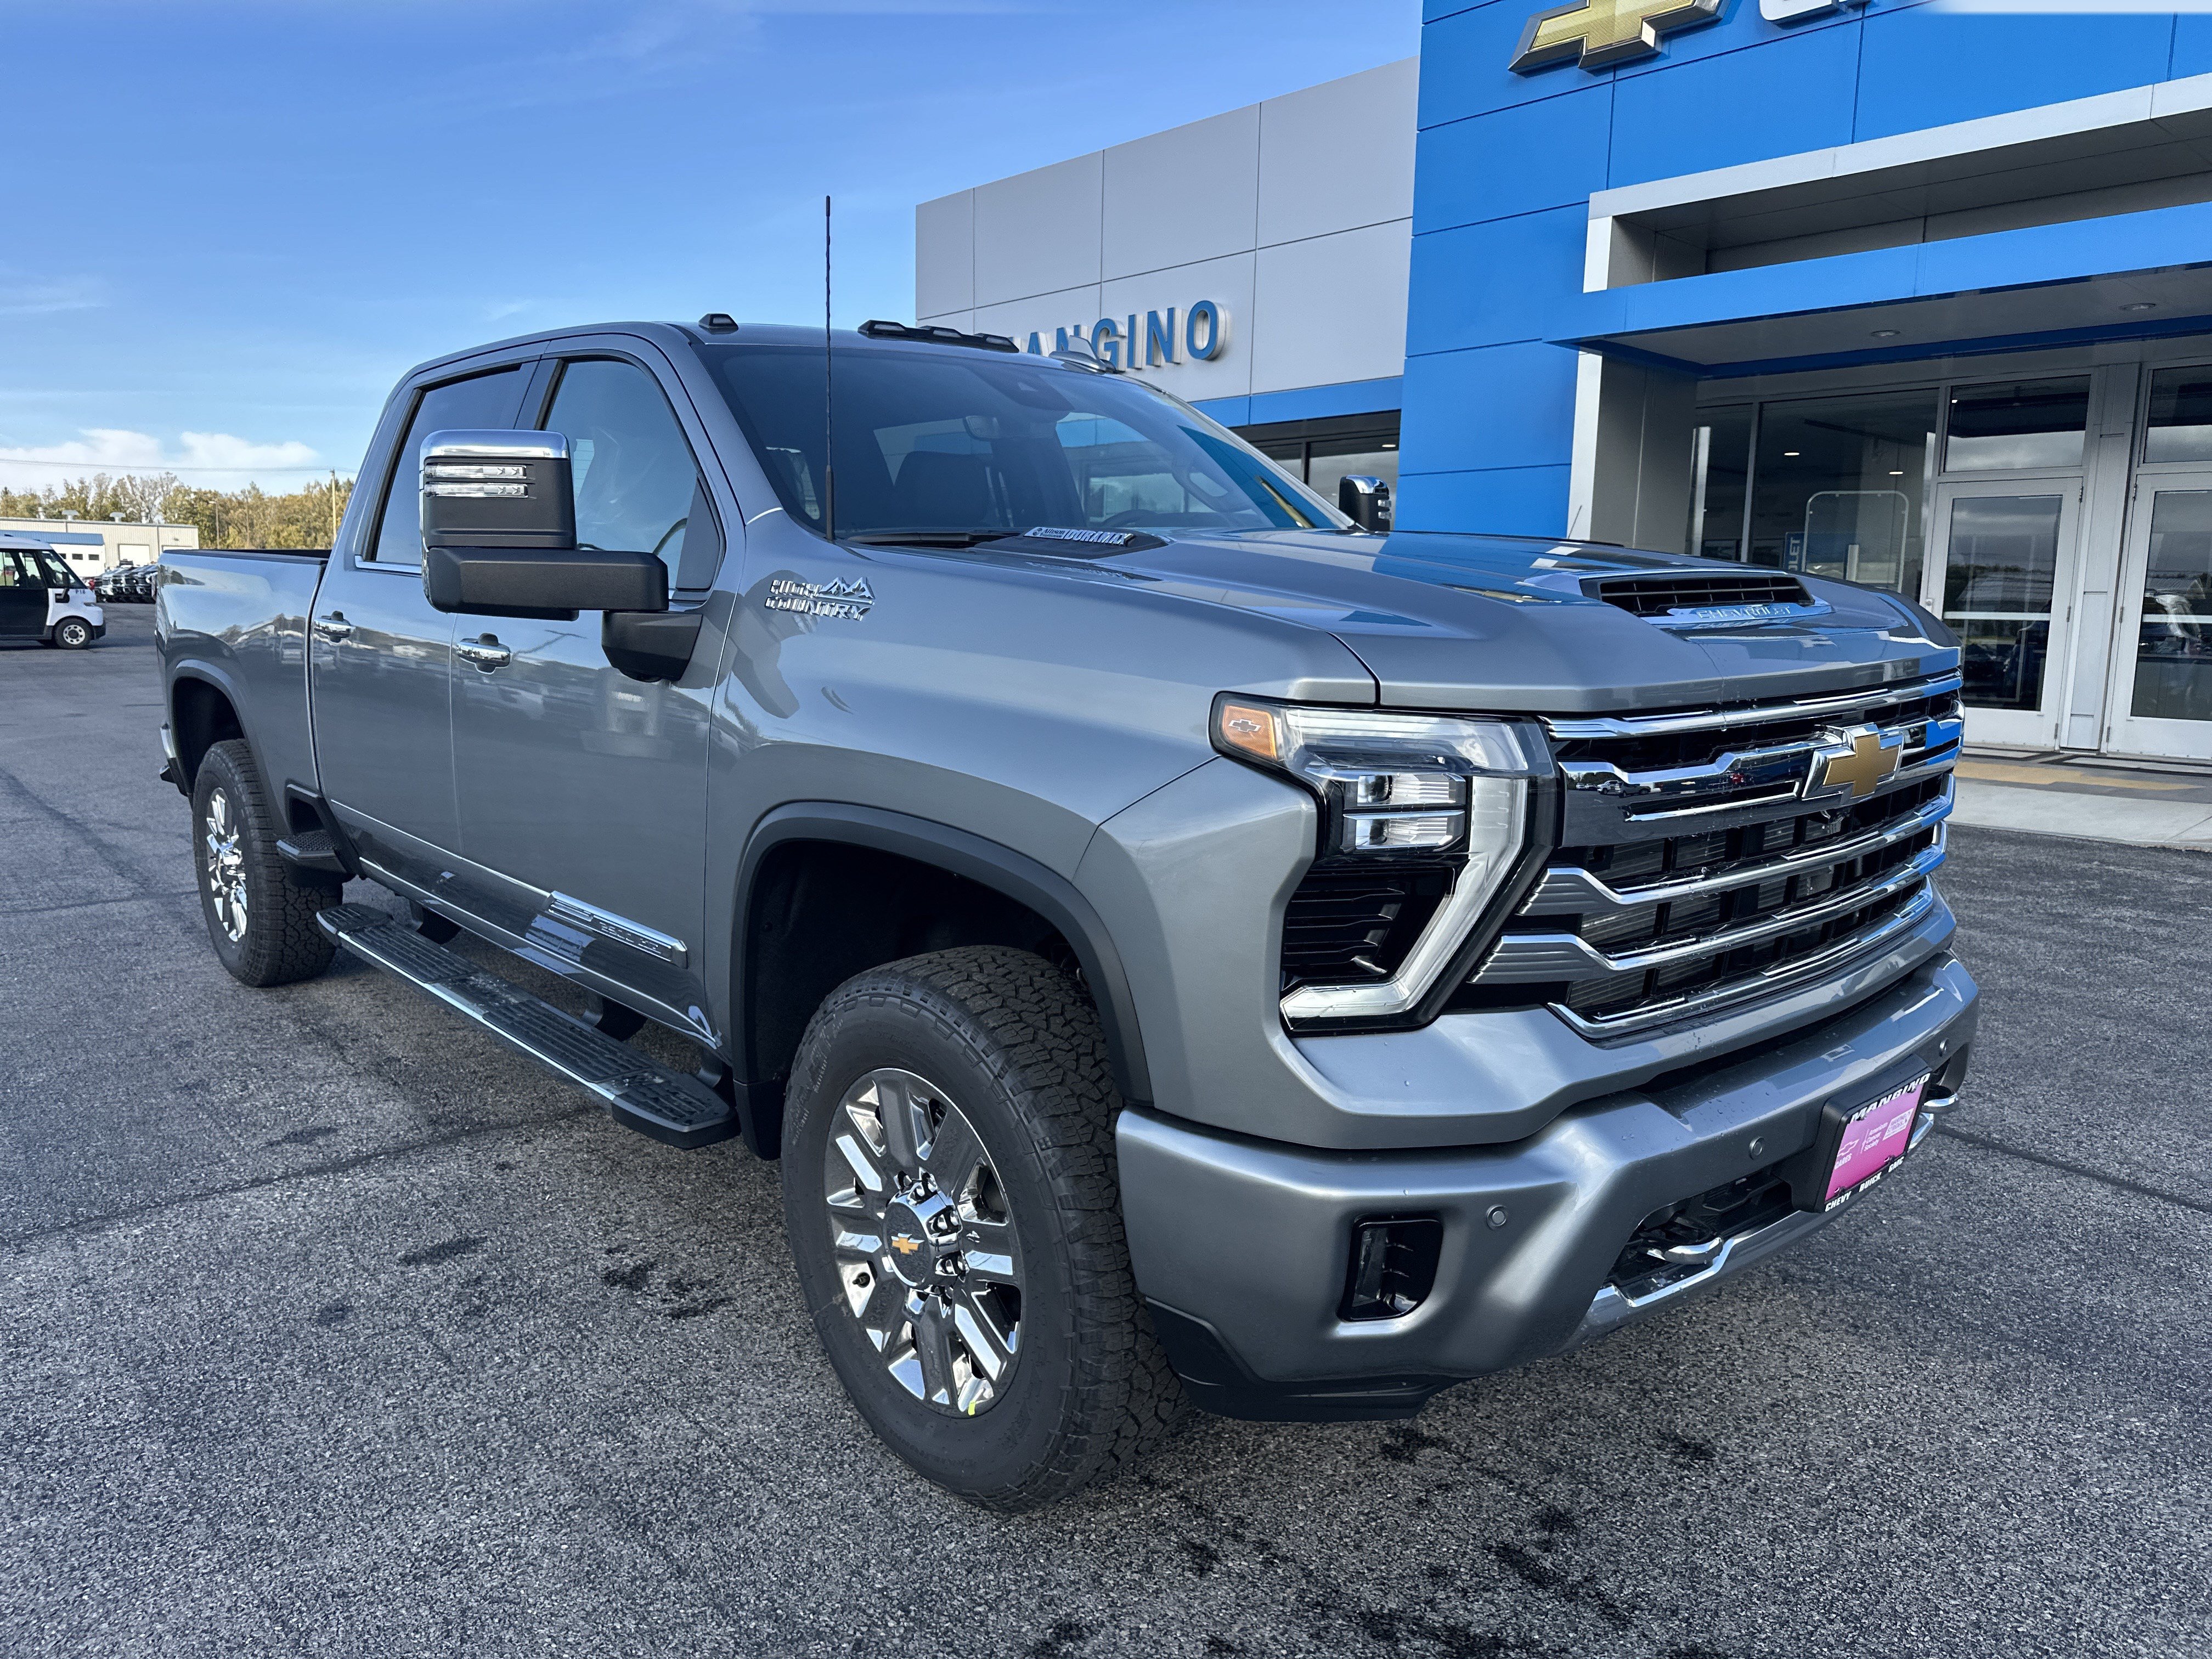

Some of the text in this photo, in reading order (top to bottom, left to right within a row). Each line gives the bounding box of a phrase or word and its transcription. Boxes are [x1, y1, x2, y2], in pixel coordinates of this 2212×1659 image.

[1009, 300, 1223, 373] ANGINO
[1063, 529, 1132, 546] DURAMAX
[770, 579, 823, 599] HIGH
[764, 596, 871, 622] COUNTRY
[1696, 604, 1792, 620] CHEVROLET
[1850, 1073, 1931, 1123] MANGINO
[1825, 1156, 1905, 1212] CHEVY BUICK GMC
